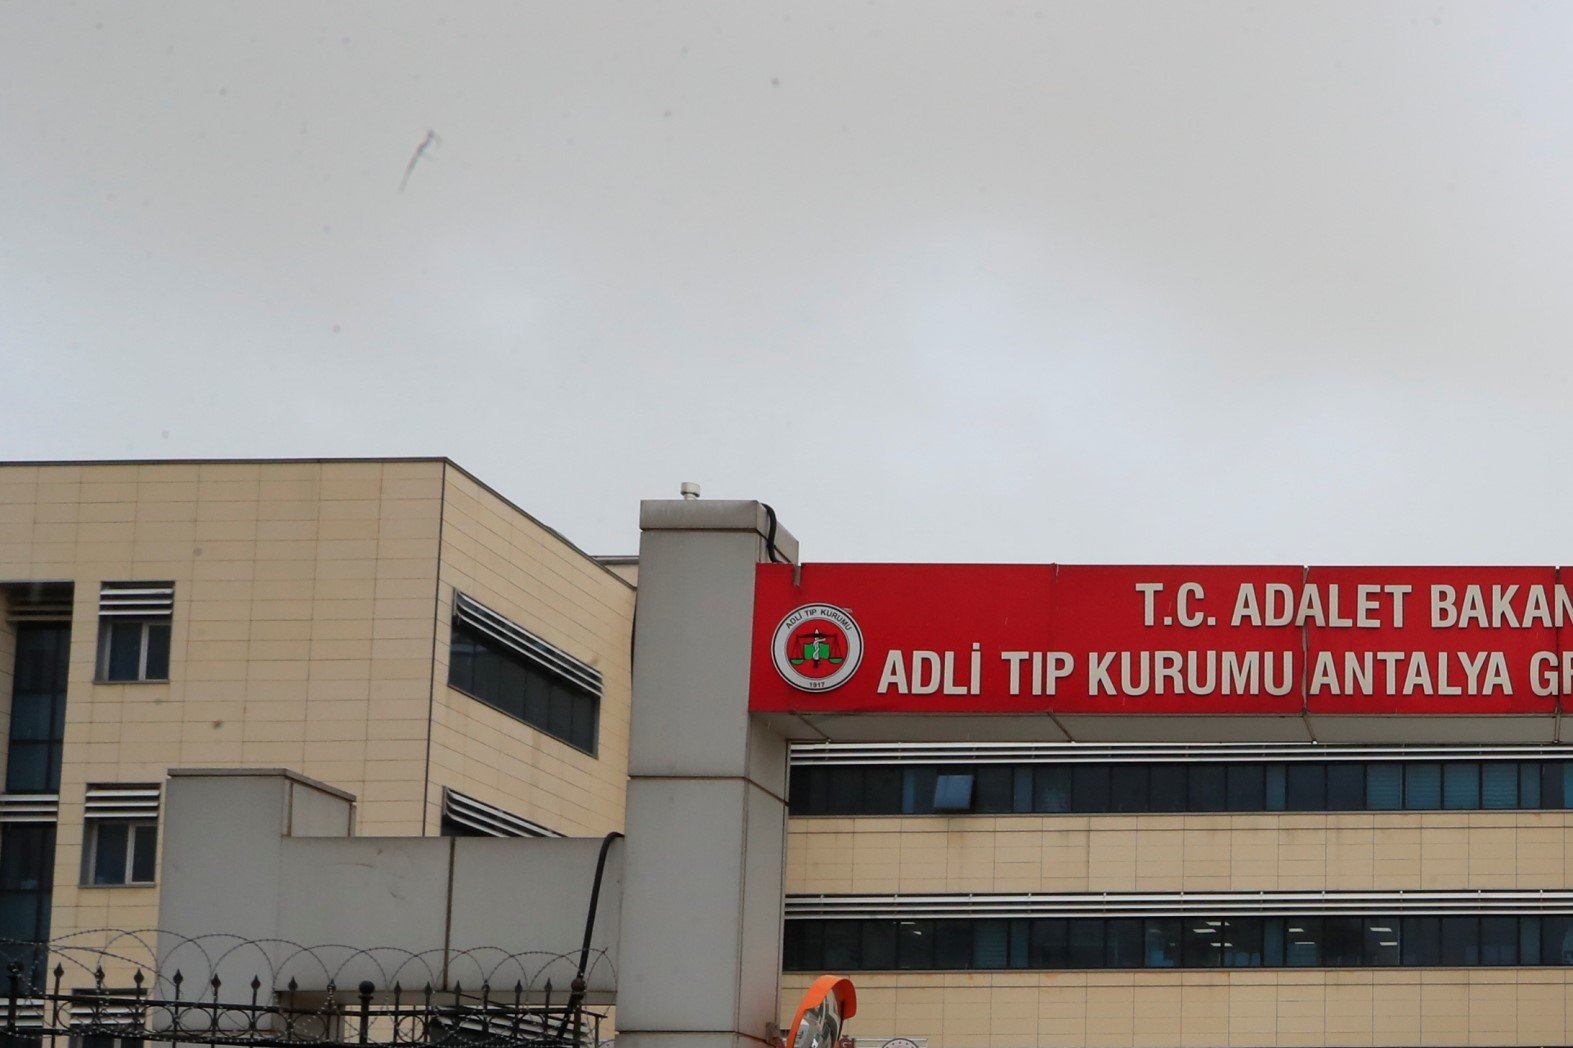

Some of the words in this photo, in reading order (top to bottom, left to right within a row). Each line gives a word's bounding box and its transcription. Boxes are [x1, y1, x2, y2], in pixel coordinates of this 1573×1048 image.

[785, 612, 803, 630] ADLİ
[804, 608, 817, 617] TIP
[820, 608, 852, 631] KURUMU
[1136, 582, 1216, 628] T.C.
[1231, 582, 1413, 628] ADALET
[809, 681, 825, 689] 1917
[878, 642, 981, 695] ADLİ
[1002, 651, 1075, 696] TIP
[1088, 650, 1293, 696] KURUMU
[1309, 651, 1514, 696] ANTALYA
